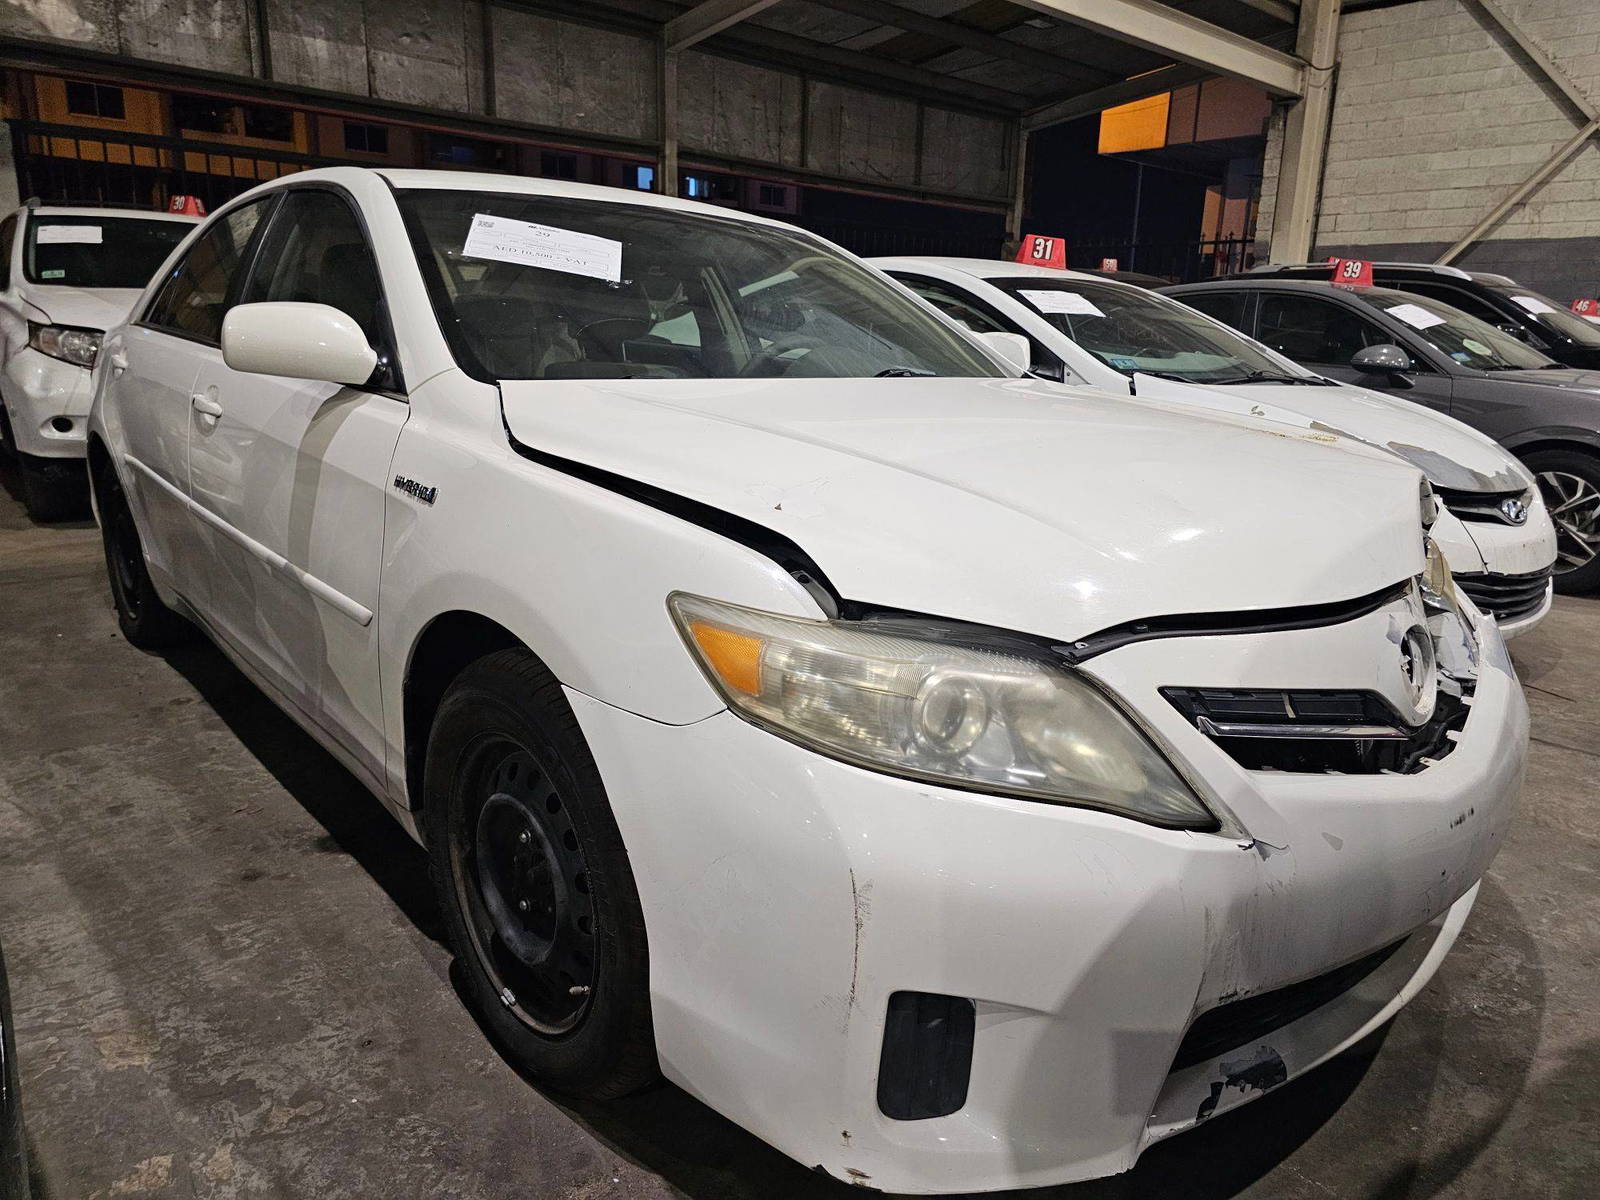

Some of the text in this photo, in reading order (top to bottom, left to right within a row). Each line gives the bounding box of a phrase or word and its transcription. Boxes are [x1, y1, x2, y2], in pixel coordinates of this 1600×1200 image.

[173, 195, 186, 210] 30
[1033, 238, 1053, 260] 31
[1343, 261, 1362, 278] 39
[1576, 300, 1590, 312] 46
[393, 474, 435, 504] HYBRID
